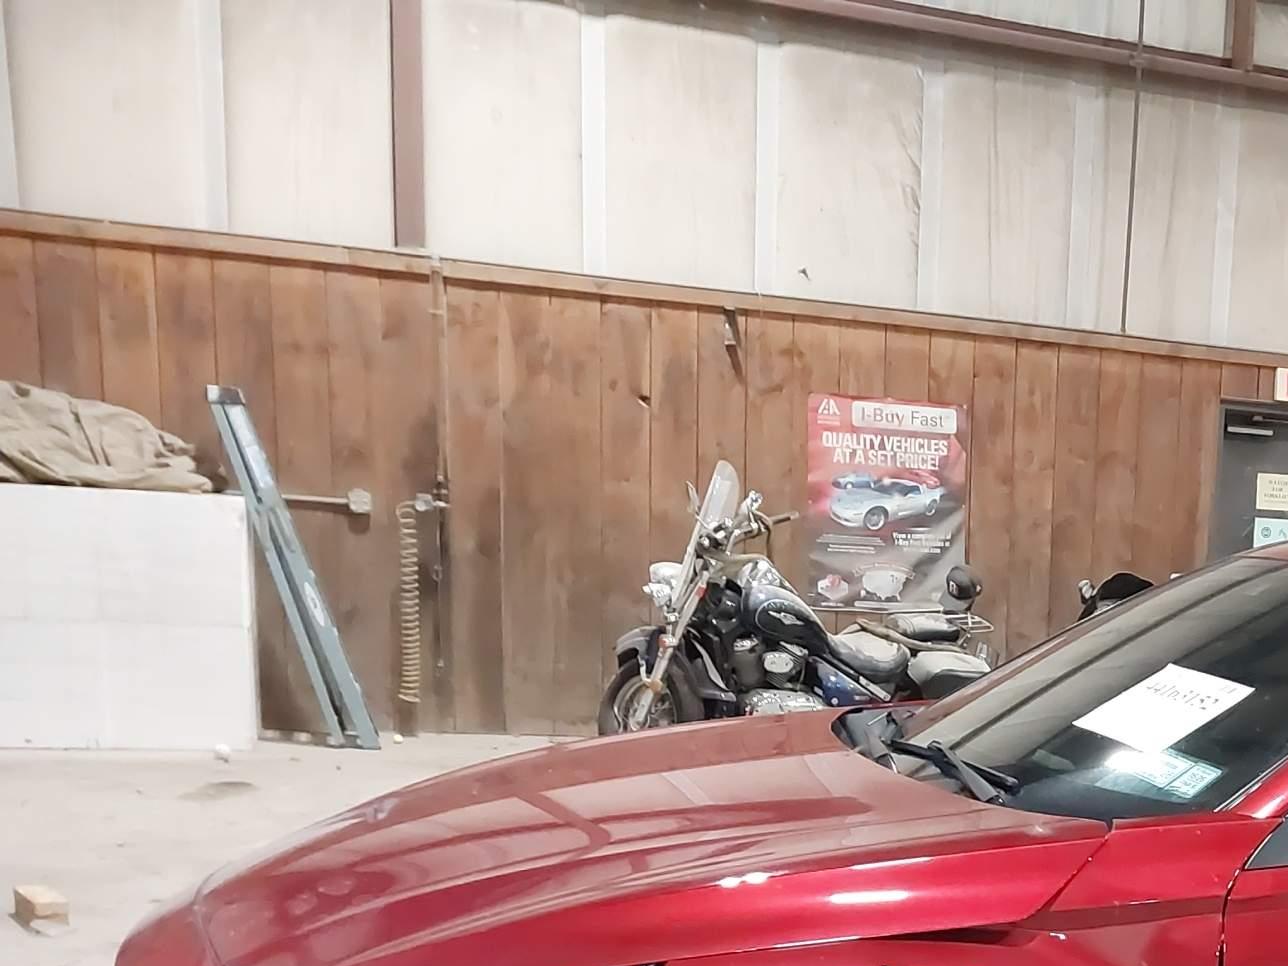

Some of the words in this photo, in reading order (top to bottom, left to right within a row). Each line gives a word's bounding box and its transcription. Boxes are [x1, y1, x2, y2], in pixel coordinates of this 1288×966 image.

[861, 406, 905, 426] I-Buy
[911, 410, 944, 428] Fast
[822, 431, 882, 450] QUALITY
[883, 436, 948, 456] VEHICLES
[833, 448, 853, 464] AT
[855, 450, 865, 465] A
[868, 451, 894, 467] SET
[896, 453, 939, 470] PRICE!
